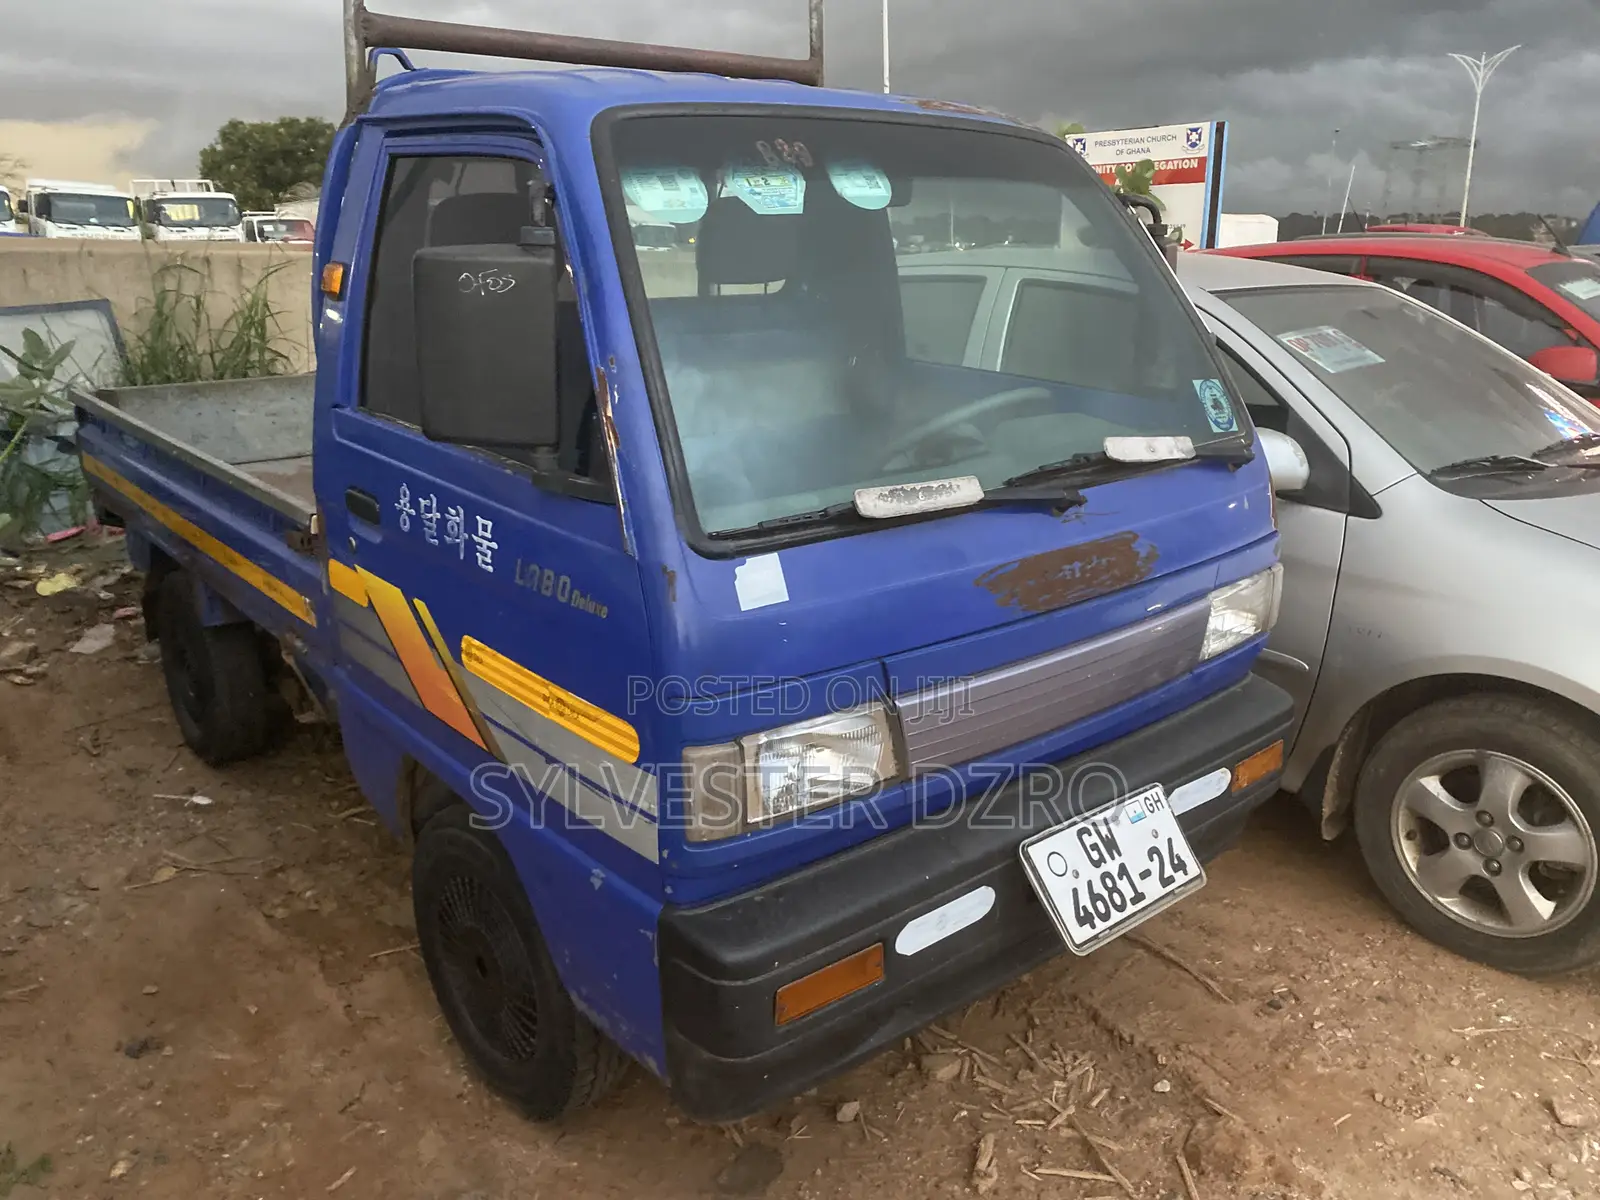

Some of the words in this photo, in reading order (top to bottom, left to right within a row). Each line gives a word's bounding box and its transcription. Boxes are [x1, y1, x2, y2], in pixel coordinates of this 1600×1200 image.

[1094, 136, 1145, 148] PRESBYTERIAN
[1147, 134, 1177, 143] CHURCH
[1115, 148, 1124, 156] OF
[1126, 147, 1151, 155] GHANA
[1092, 165, 1116, 174] NITY
[395, 482, 498, 573] 용달화물
[571, 589, 608, 619] Deluxe
[1143, 791, 1165, 814] GH
[1076, 817, 1122, 868] GW
[1072, 837, 1188, 930] 4681-24
